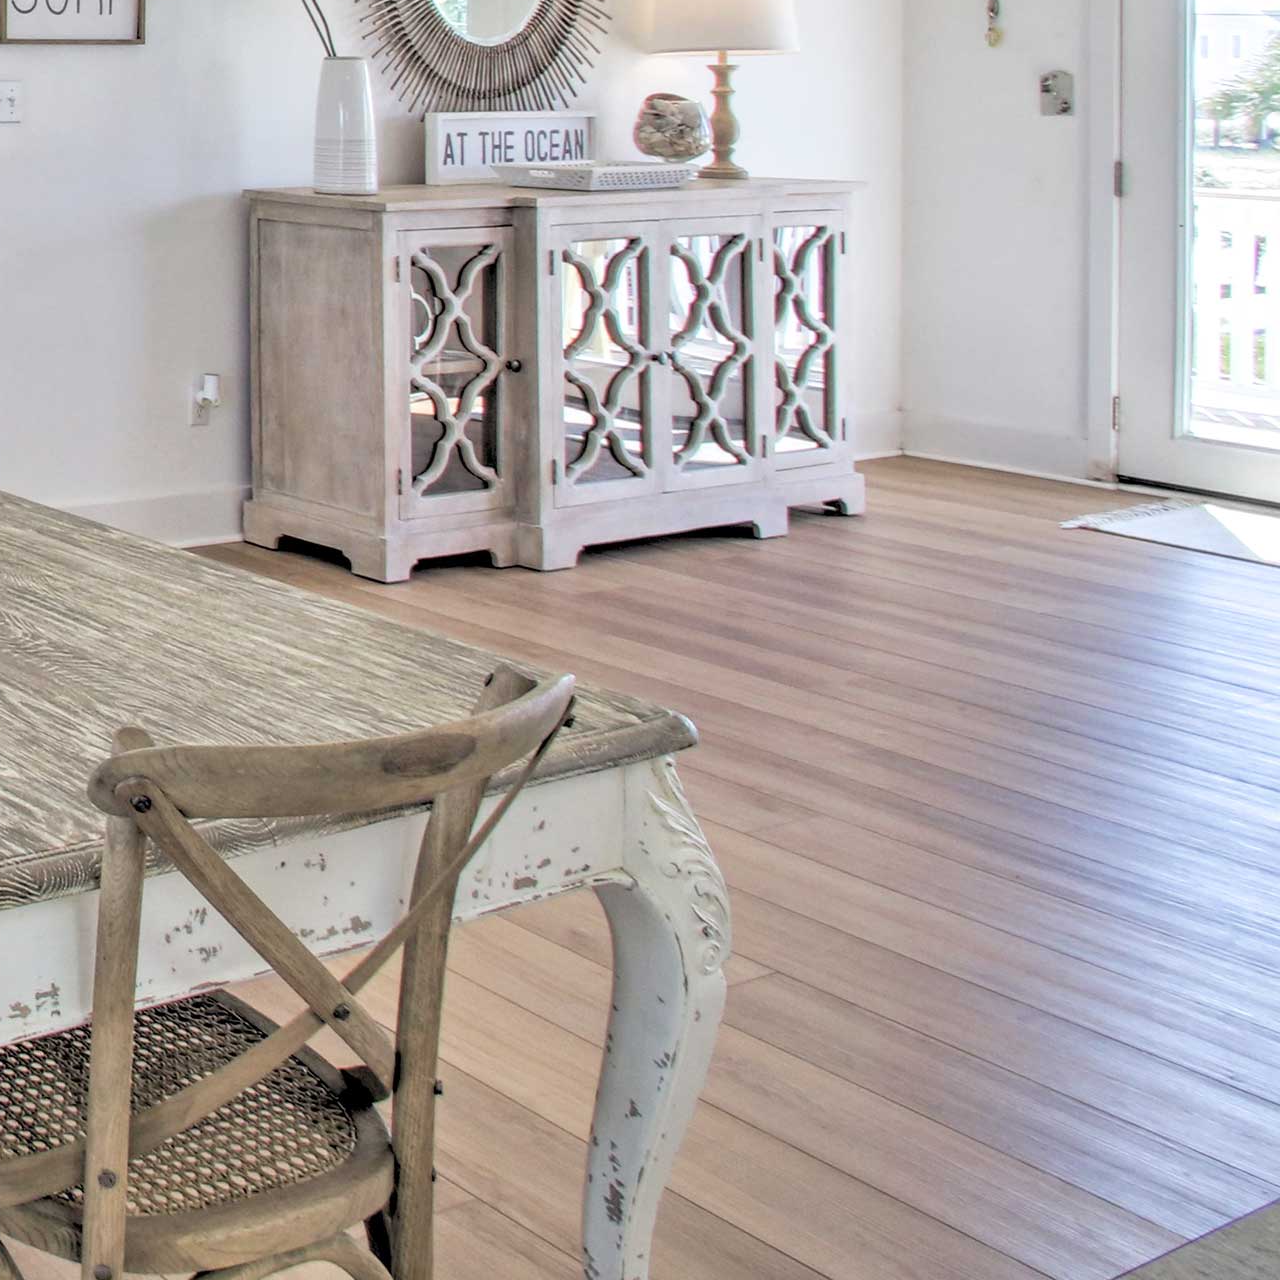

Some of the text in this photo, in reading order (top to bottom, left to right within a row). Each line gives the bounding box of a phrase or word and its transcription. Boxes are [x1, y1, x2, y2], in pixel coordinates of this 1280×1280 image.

[442, 128, 585, 166] AT THE OCEAN
